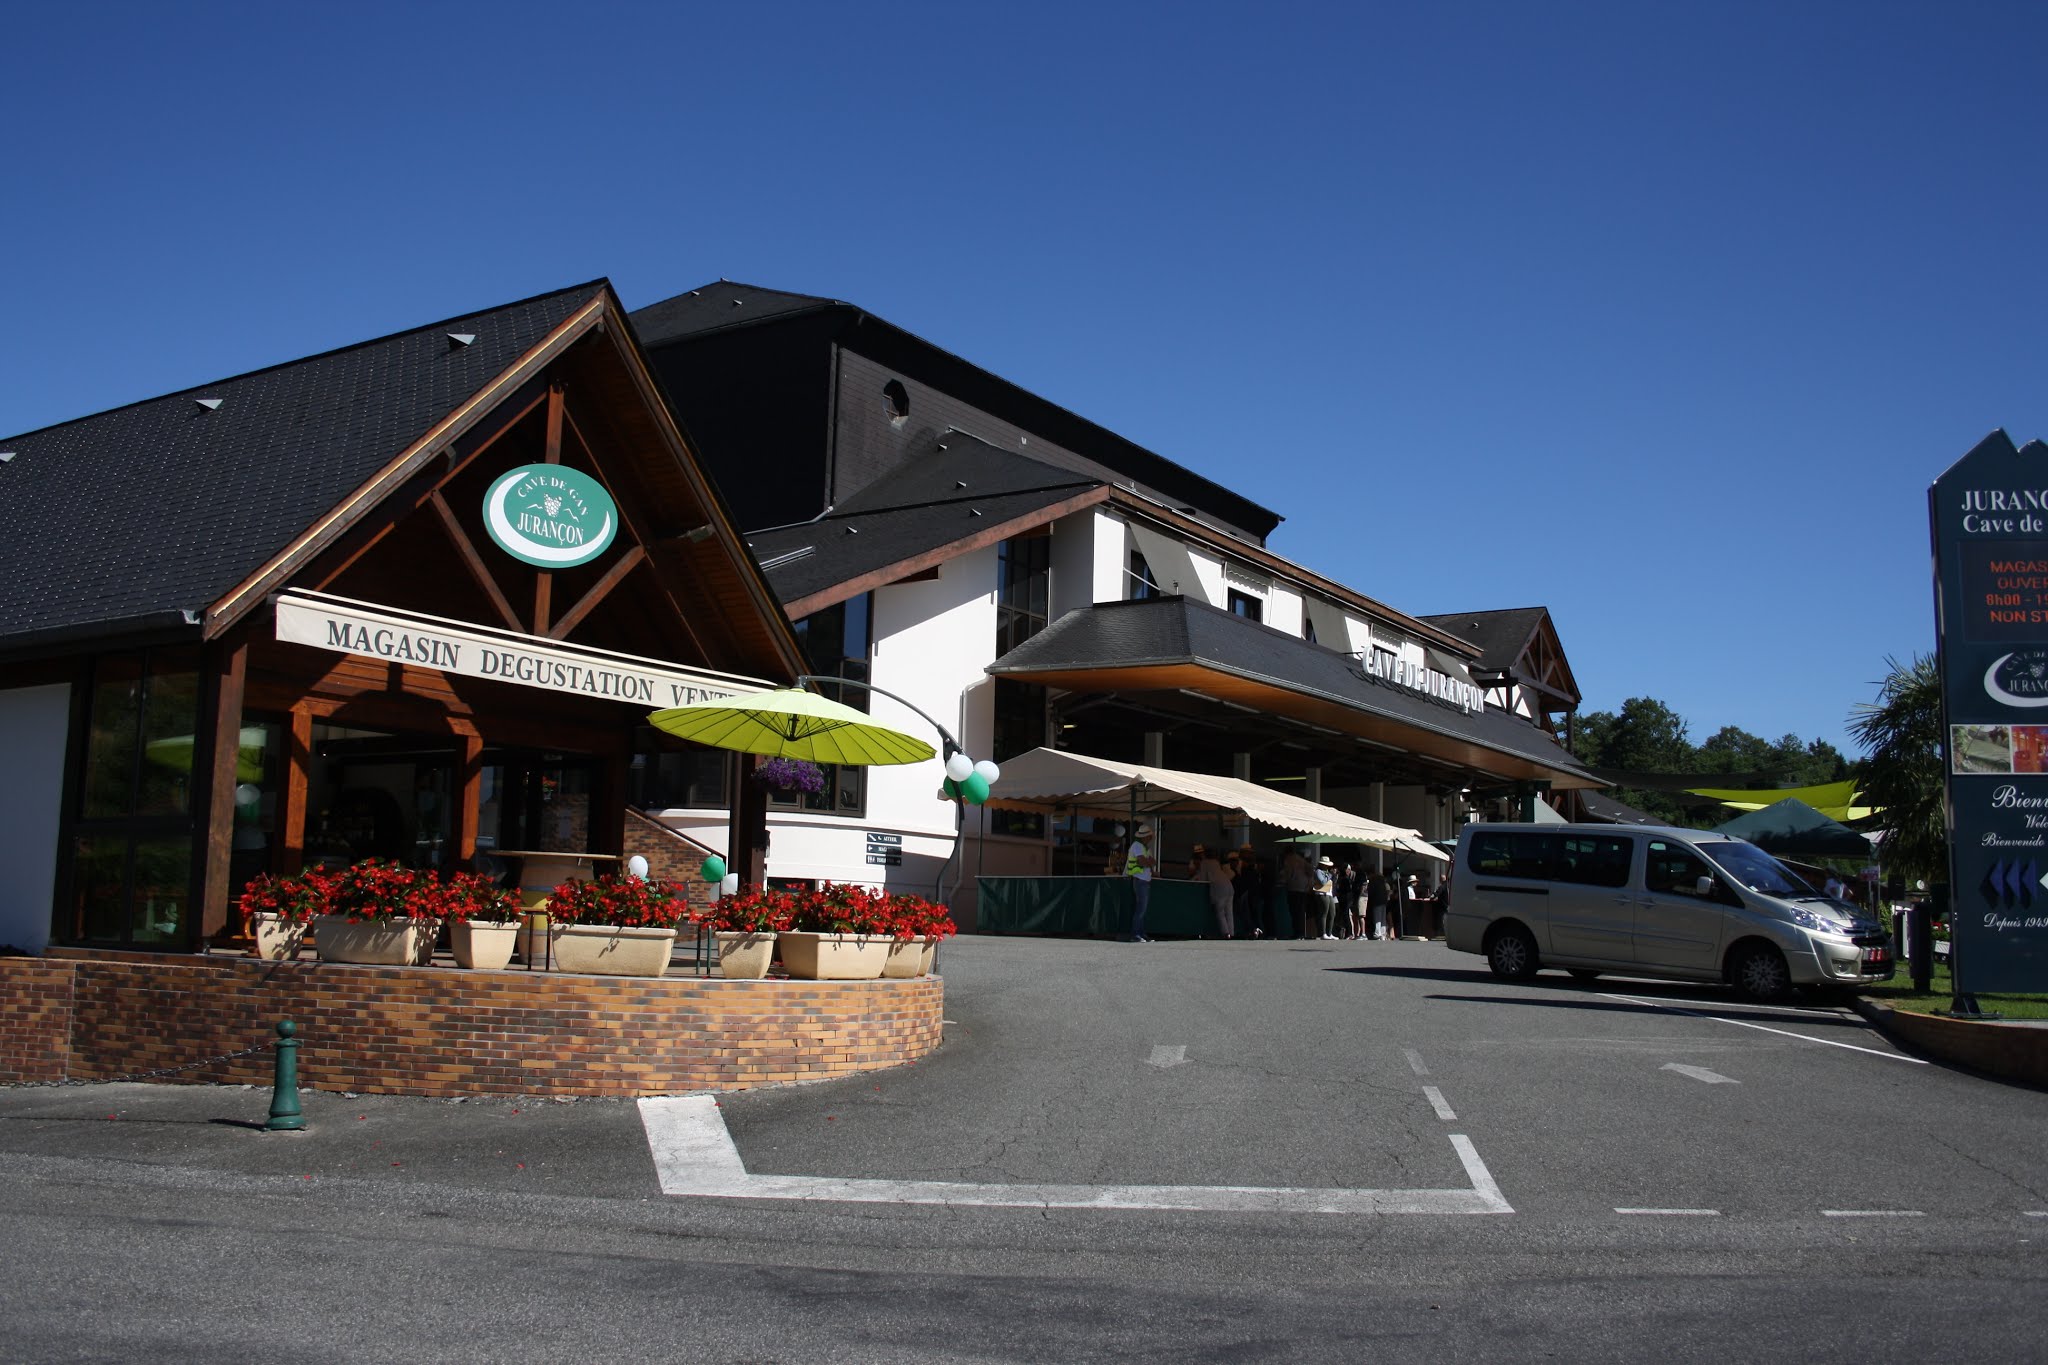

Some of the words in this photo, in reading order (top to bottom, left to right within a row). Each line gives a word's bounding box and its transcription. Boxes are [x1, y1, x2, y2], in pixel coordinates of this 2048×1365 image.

[517, 476, 547, 498] CAVE
[551, 477, 566, 491] DE
[569, 488, 588, 516] GAN
[517, 511, 584, 545] JURANÇON
[1962, 514, 2013, 533] Cave
[2019, 514, 2043, 532] de
[1986, 594, 2020, 606] 8h00
[1990, 611, 2026, 623] NON
[327, 619, 461, 669] MAGASIN
[480, 648, 655, 702] DEGUSTATION
[671, 684, 737, 706] VEN
[1363, 645, 1404, 684] CAVE
[1402, 661, 1424, 691] DE
[1422, 667, 1485, 714] JURANÇON
[1981, 832, 2045, 846] Bienvenido
[1983, 912, 2021, 931] Depuis
